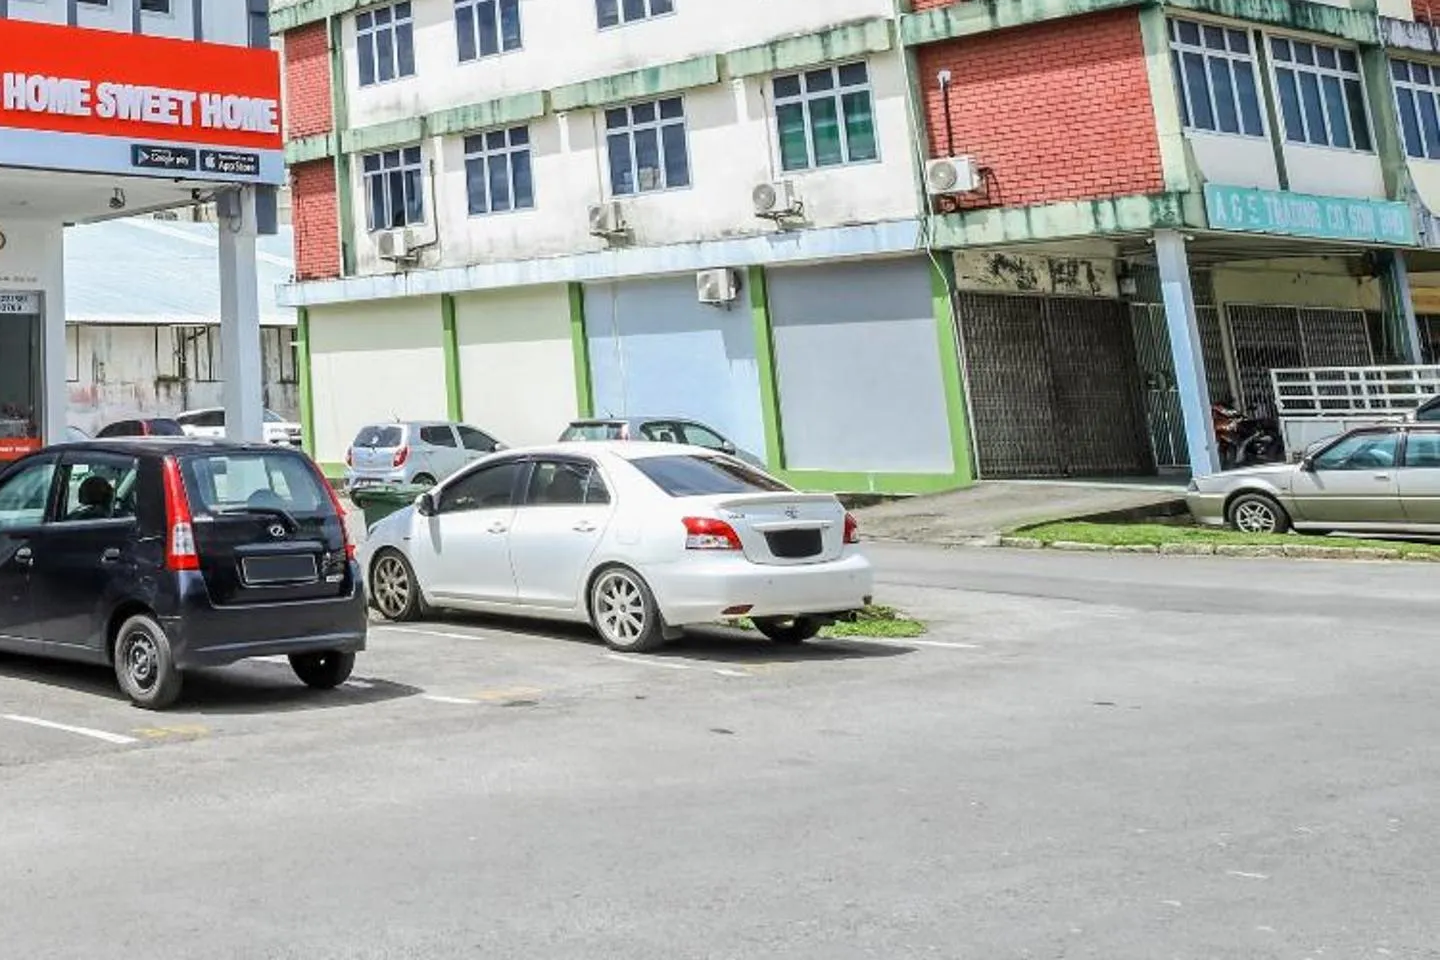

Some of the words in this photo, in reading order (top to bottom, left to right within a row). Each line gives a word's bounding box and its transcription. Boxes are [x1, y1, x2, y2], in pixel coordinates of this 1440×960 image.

[3, 71, 91, 117] HOME
[96, 82, 197, 127] SWEET
[199, 93, 279, 134] HOME
